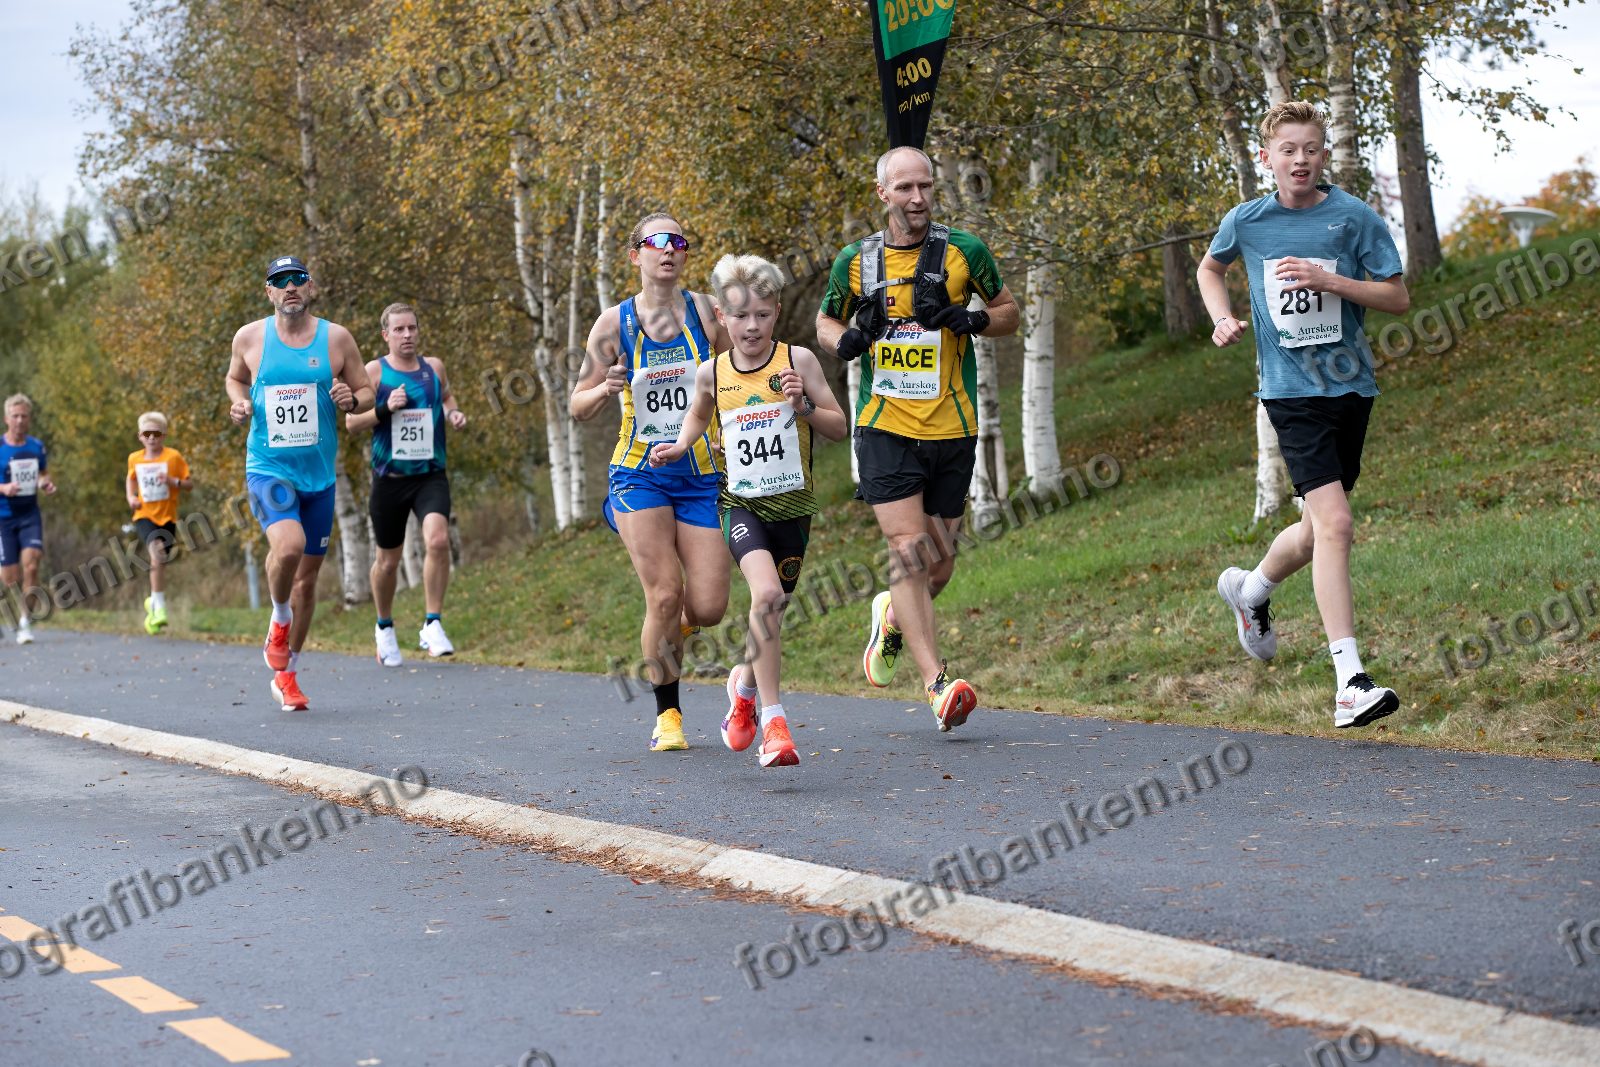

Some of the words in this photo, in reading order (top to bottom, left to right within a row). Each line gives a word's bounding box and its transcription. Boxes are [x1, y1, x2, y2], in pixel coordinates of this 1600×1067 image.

[896, 57, 932, 88] 4:00
[1279, 288, 1323, 316] 281
[891, 331, 923, 340] LØPET
[1297, 323, 1339, 337] Aurskog
[881, 346, 934, 369] PACE
[645, 367, 686, 381] NORGES
[649, 375, 681, 386] LØPET
[276, 387, 308, 396] NORGES
[899, 380, 937, 392] Aurskog
[278, 394, 303, 402] LØPET
[646, 386, 688, 413] 840
[275, 404, 308, 425] 912
[736, 408, 781, 424] NORGES
[663, 421, 683, 432] Aur
[740, 418, 775, 432] LØPET
[288, 430, 318, 440] Aurskog
[400, 425, 424, 442] 251
[737, 433, 785, 467] 344
[760, 471, 801, 486] Aurskog
